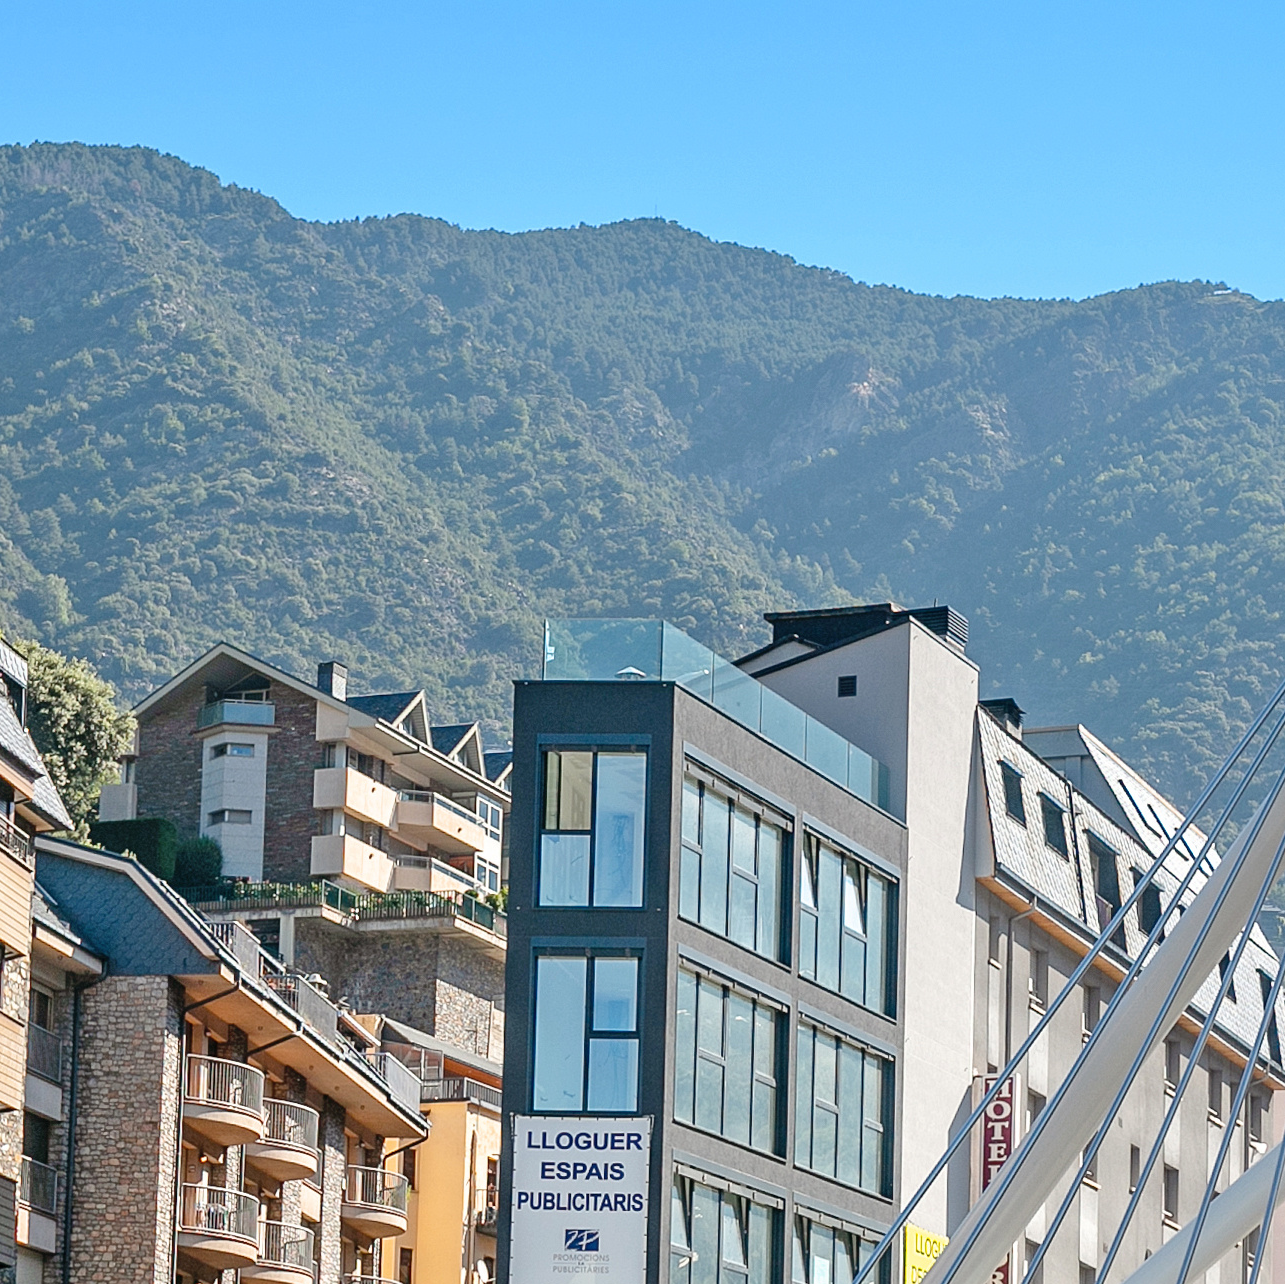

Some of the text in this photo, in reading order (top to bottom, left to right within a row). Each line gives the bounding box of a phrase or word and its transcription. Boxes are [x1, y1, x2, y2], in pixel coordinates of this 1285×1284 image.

[527, 1131, 643, 1150] LLOGUER
[540, 1161, 625, 1181] ESPAIS
[517, 1191, 644, 1211] PUBLICITARIS
[552, 1253, 610, 1262] PROMOCIONS
